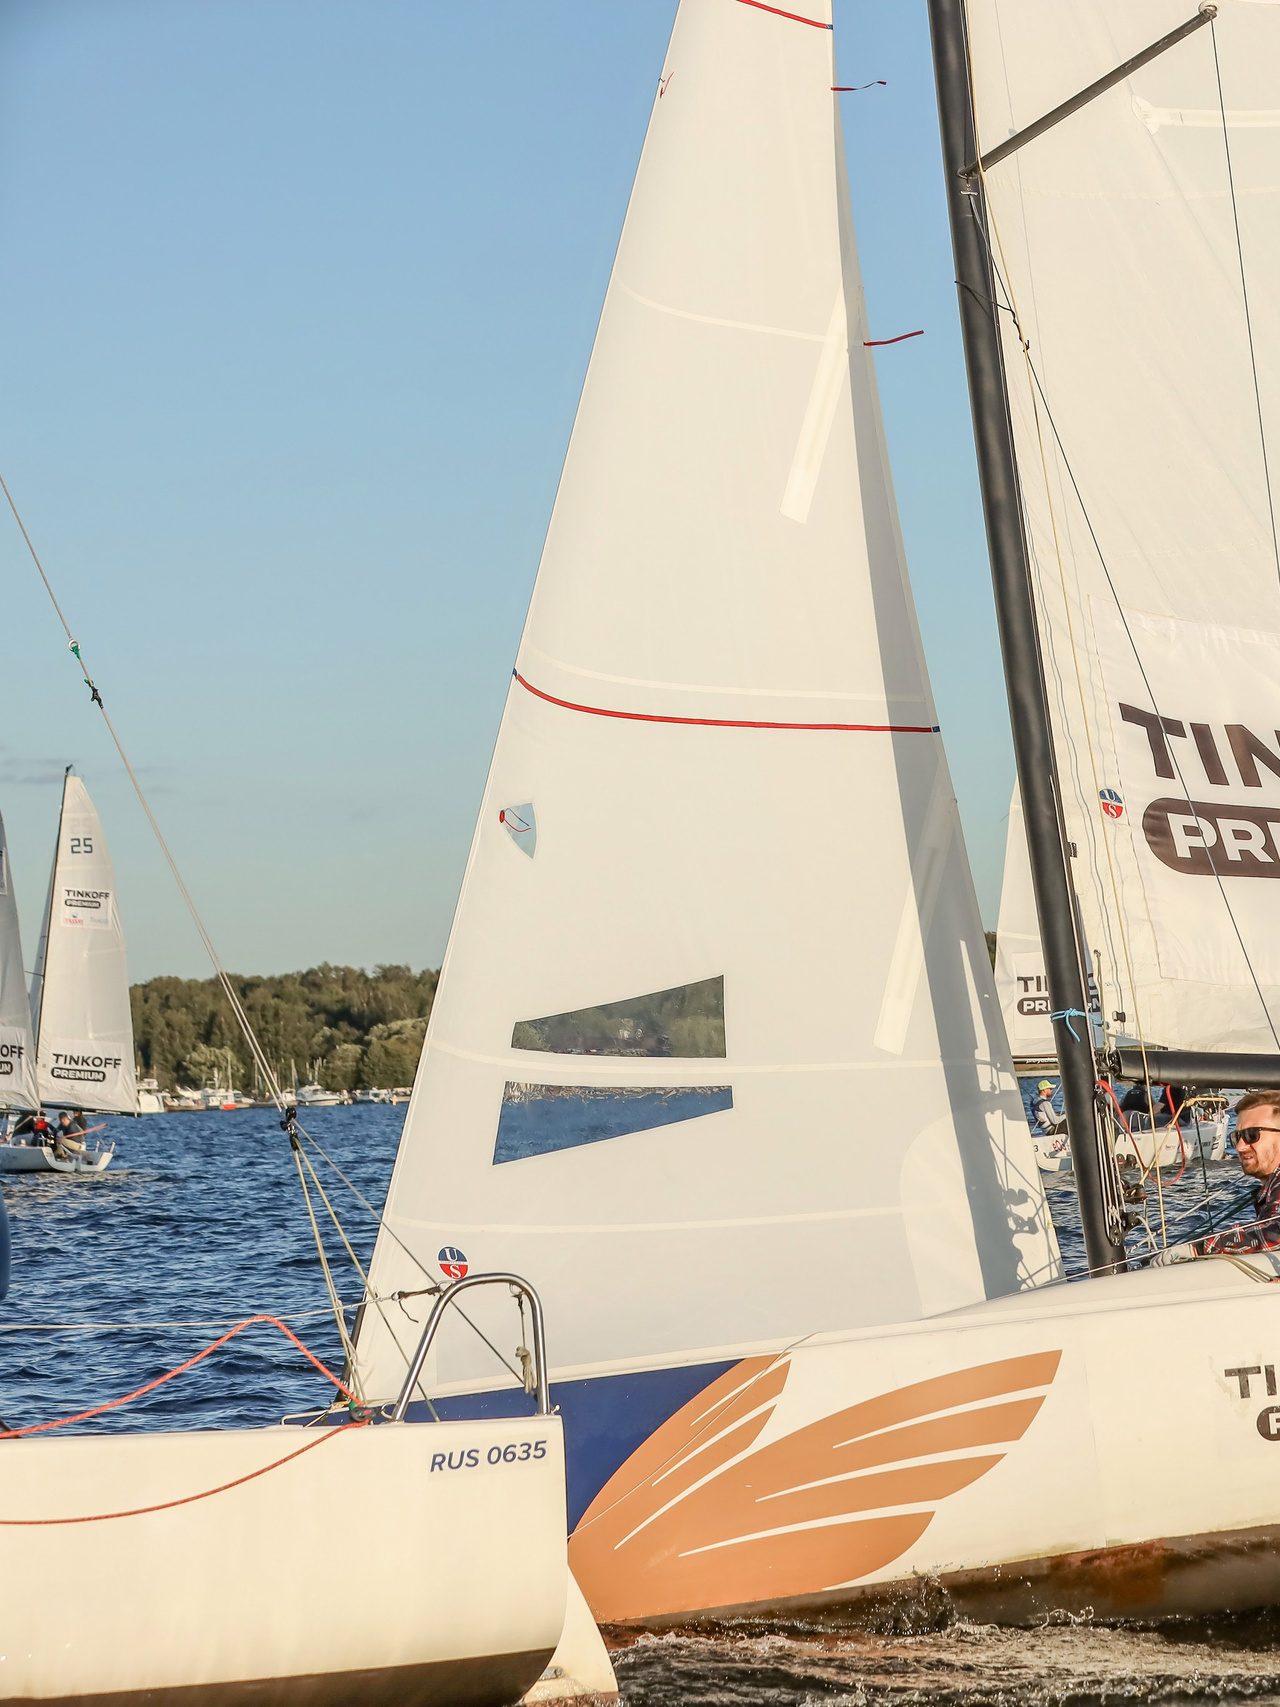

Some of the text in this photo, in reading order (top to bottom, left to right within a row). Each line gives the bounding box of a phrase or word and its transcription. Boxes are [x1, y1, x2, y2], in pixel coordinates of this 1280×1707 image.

[70, 837, 94, 854] 25
[64, 889, 110, 900] TINKOFF
[52, 1053, 122, 1069] TINKOFF
[53, 1068, 104, 1081] PREMIUM
[430, 1440, 548, 1473] RUS 0635
